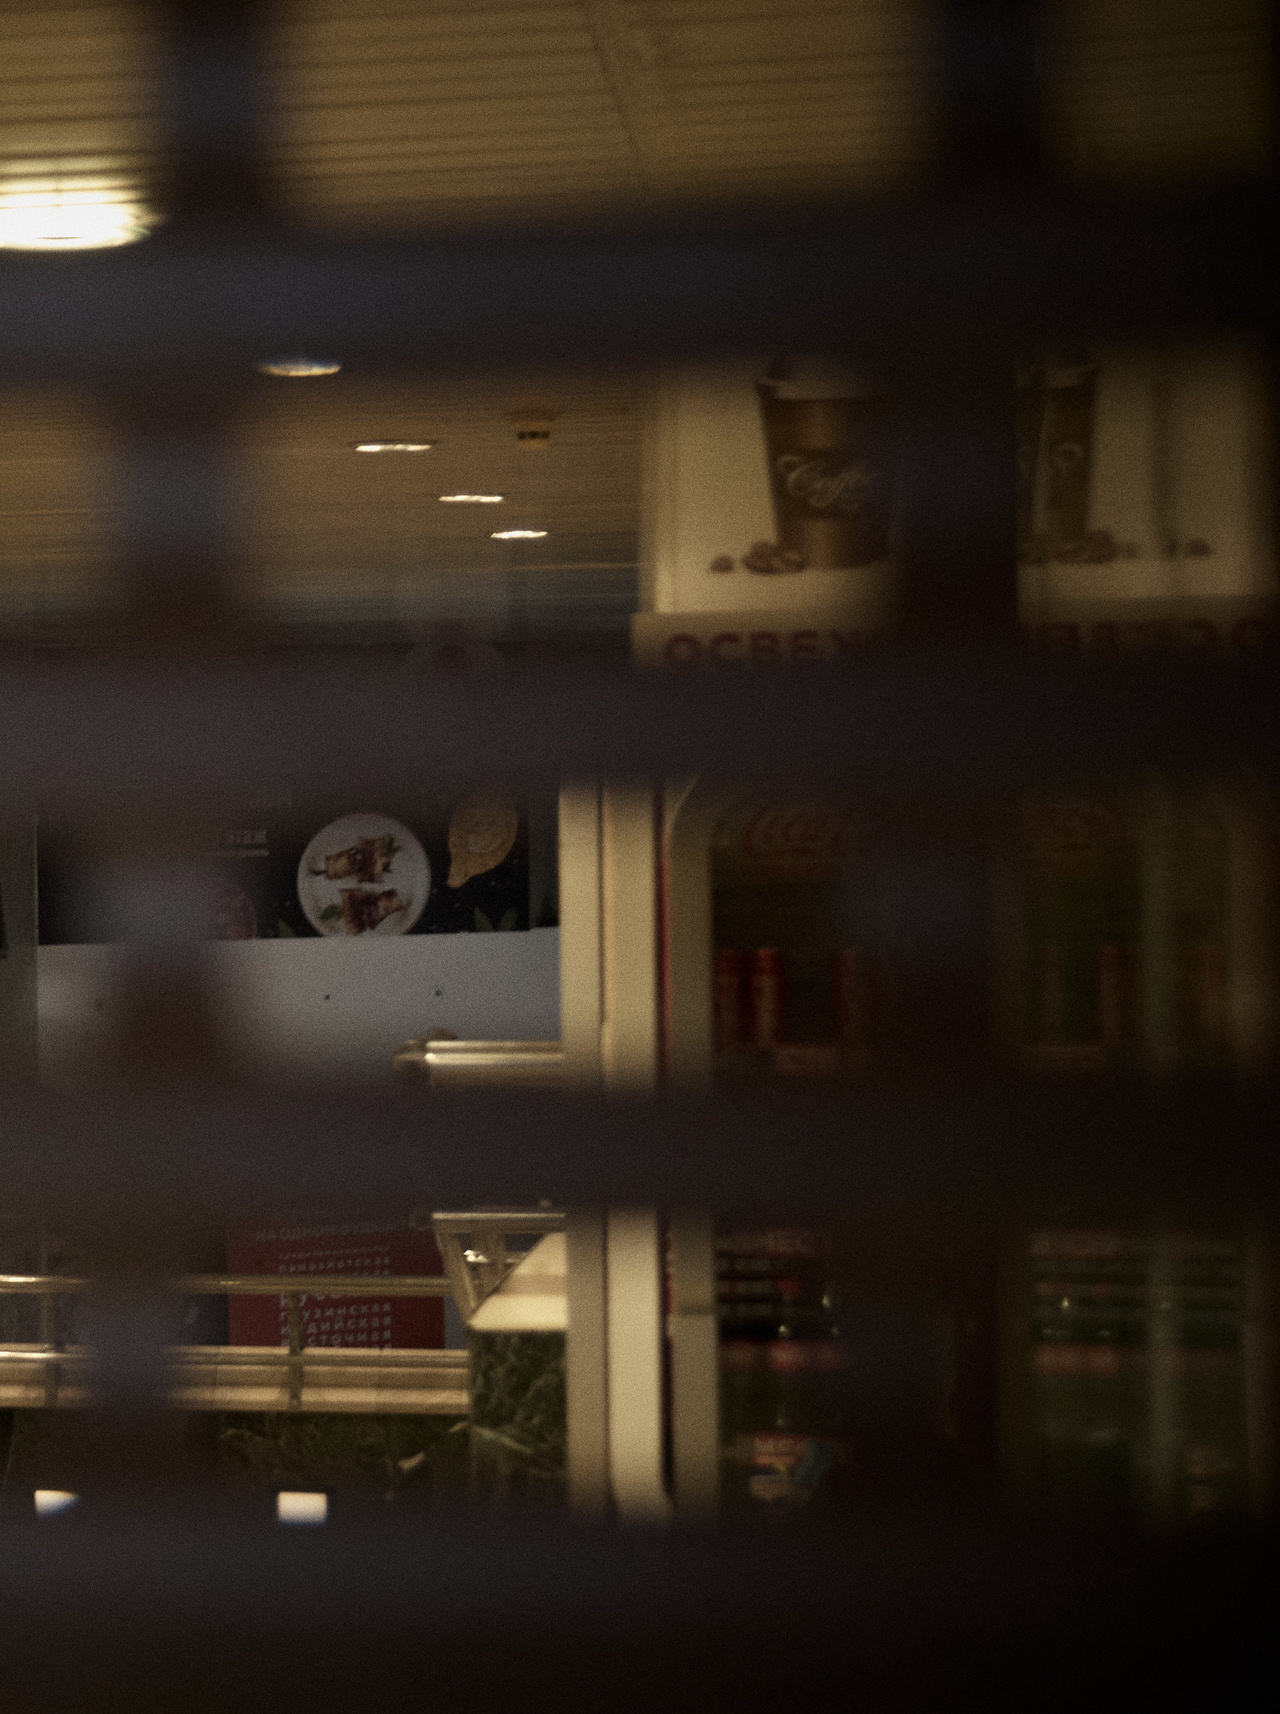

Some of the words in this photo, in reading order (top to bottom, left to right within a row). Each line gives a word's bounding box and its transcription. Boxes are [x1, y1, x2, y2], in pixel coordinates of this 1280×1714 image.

[278, 1301, 393, 1322] гузинская
[279, 1314, 393, 1335] идийская
[280, 1328, 393, 1347] всточная
